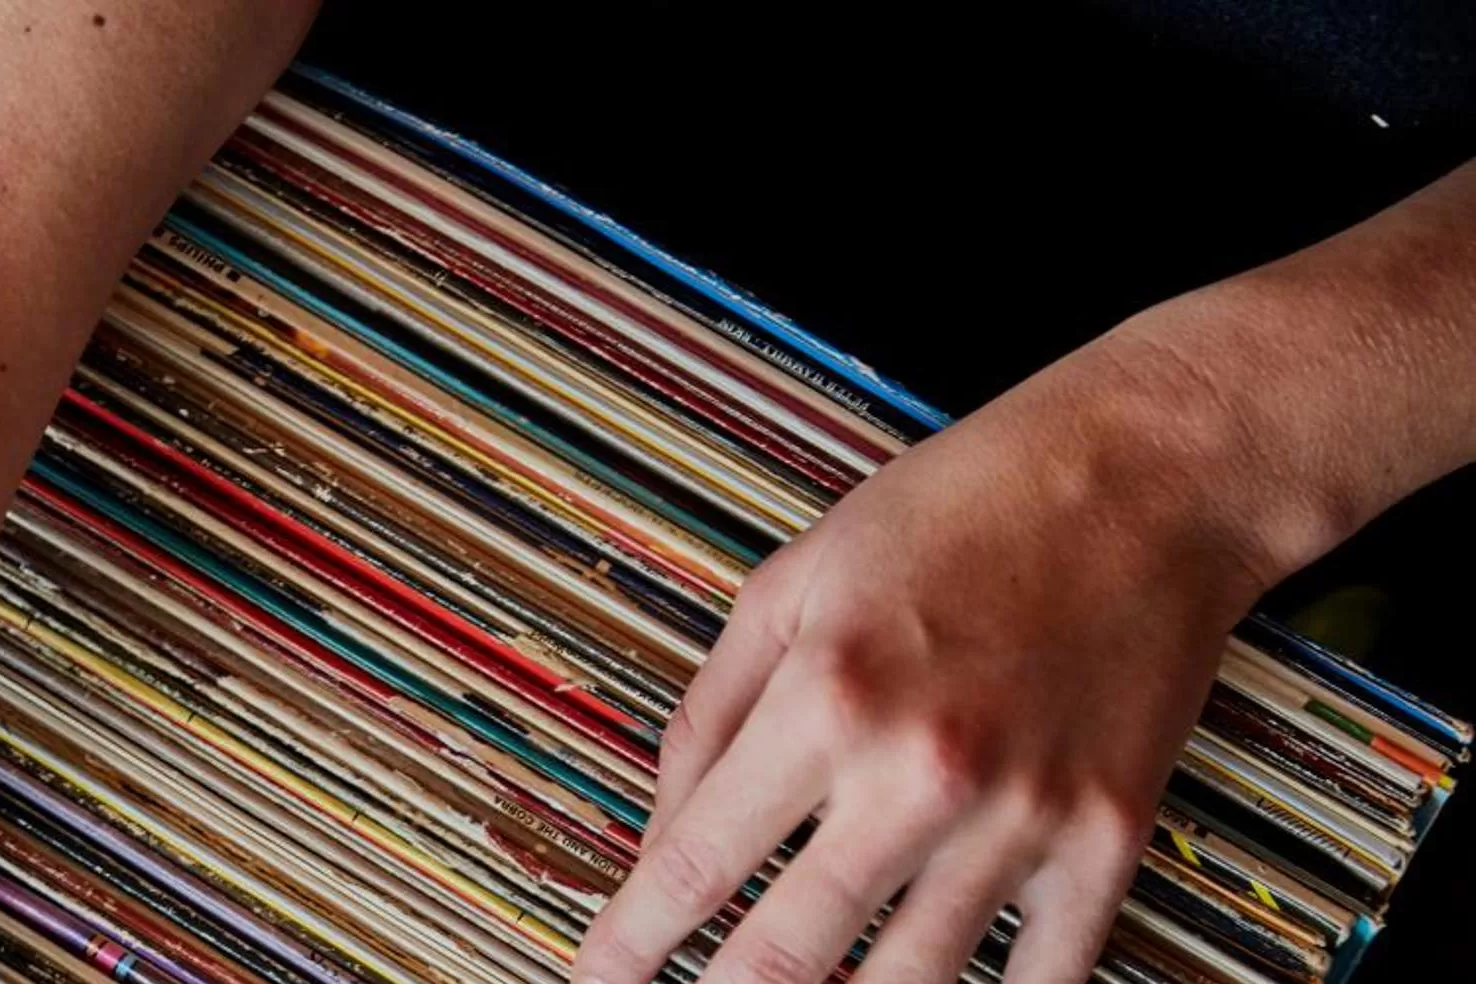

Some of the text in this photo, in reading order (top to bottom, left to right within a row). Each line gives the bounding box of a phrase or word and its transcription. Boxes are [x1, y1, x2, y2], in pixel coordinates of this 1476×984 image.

[166, 236, 225, 275] PHILIPS
[491, 795, 619, 876] LION AND THE COBRA
